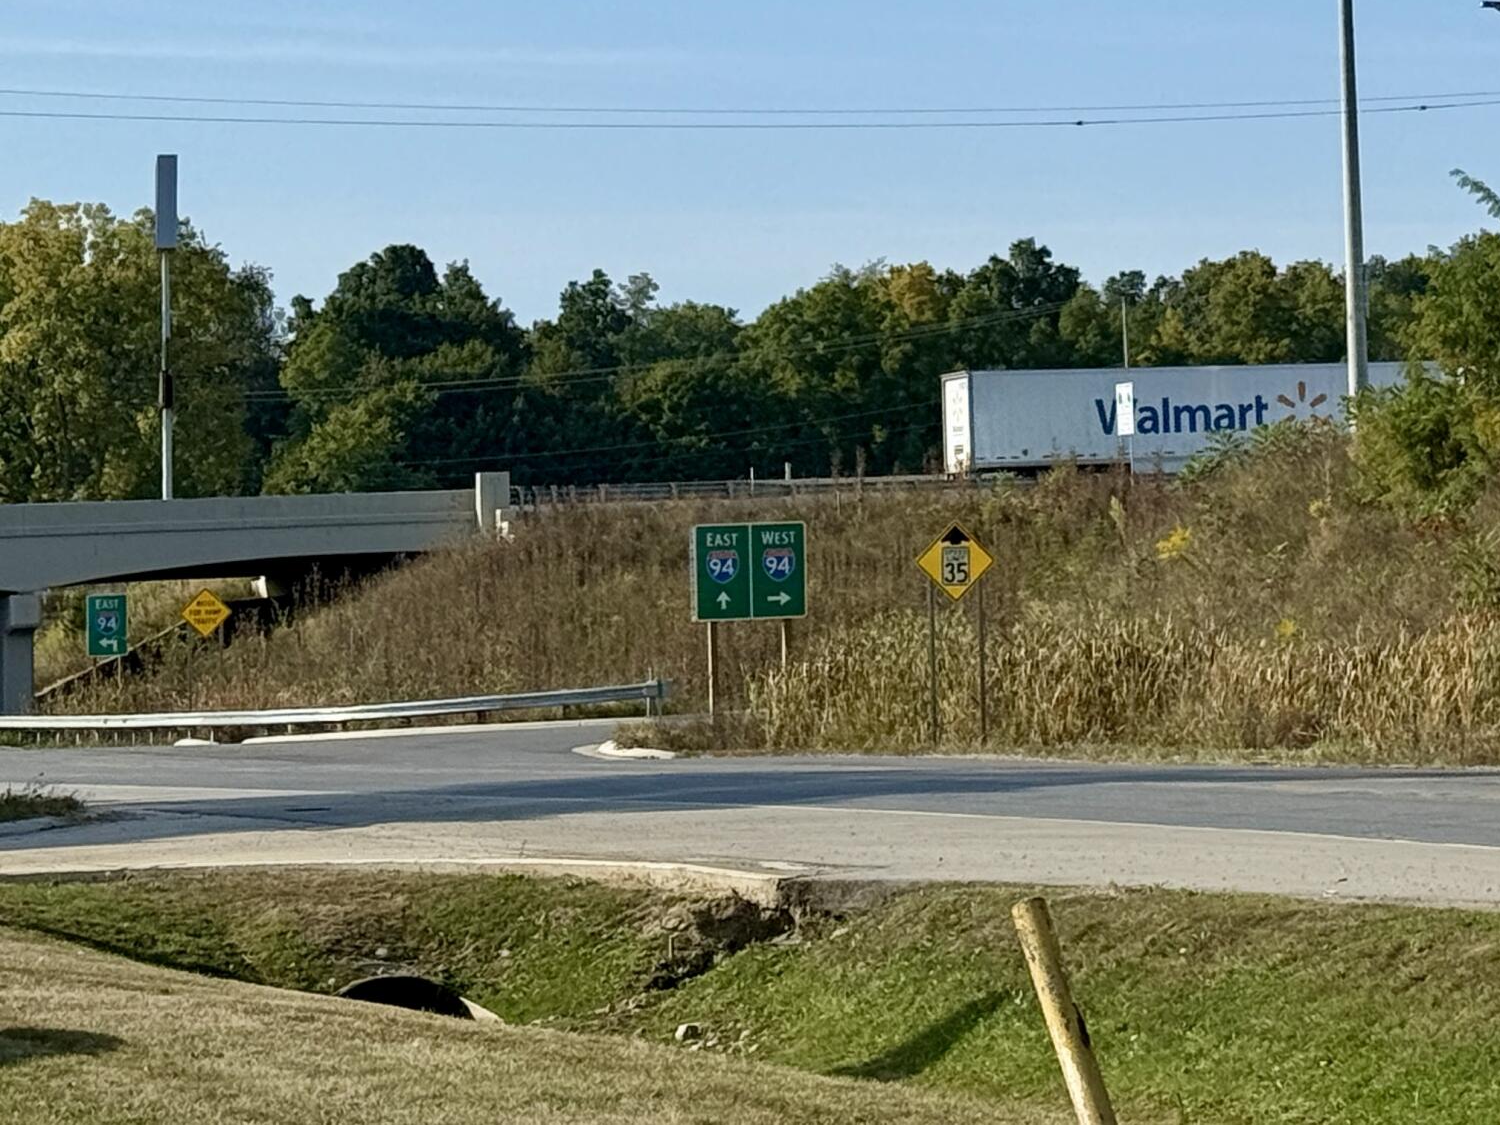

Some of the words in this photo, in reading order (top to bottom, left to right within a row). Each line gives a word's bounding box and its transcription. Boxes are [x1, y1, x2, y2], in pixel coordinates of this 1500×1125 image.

[706, 532, 738, 547] EAST
[761, 530, 796, 545] WEST
[709, 558, 734, 577] 94
[766, 556, 791, 575] 94
[944, 562, 968, 583] 35
[96, 598, 118, 610] EAST
[97, 617, 117, 631] 94
